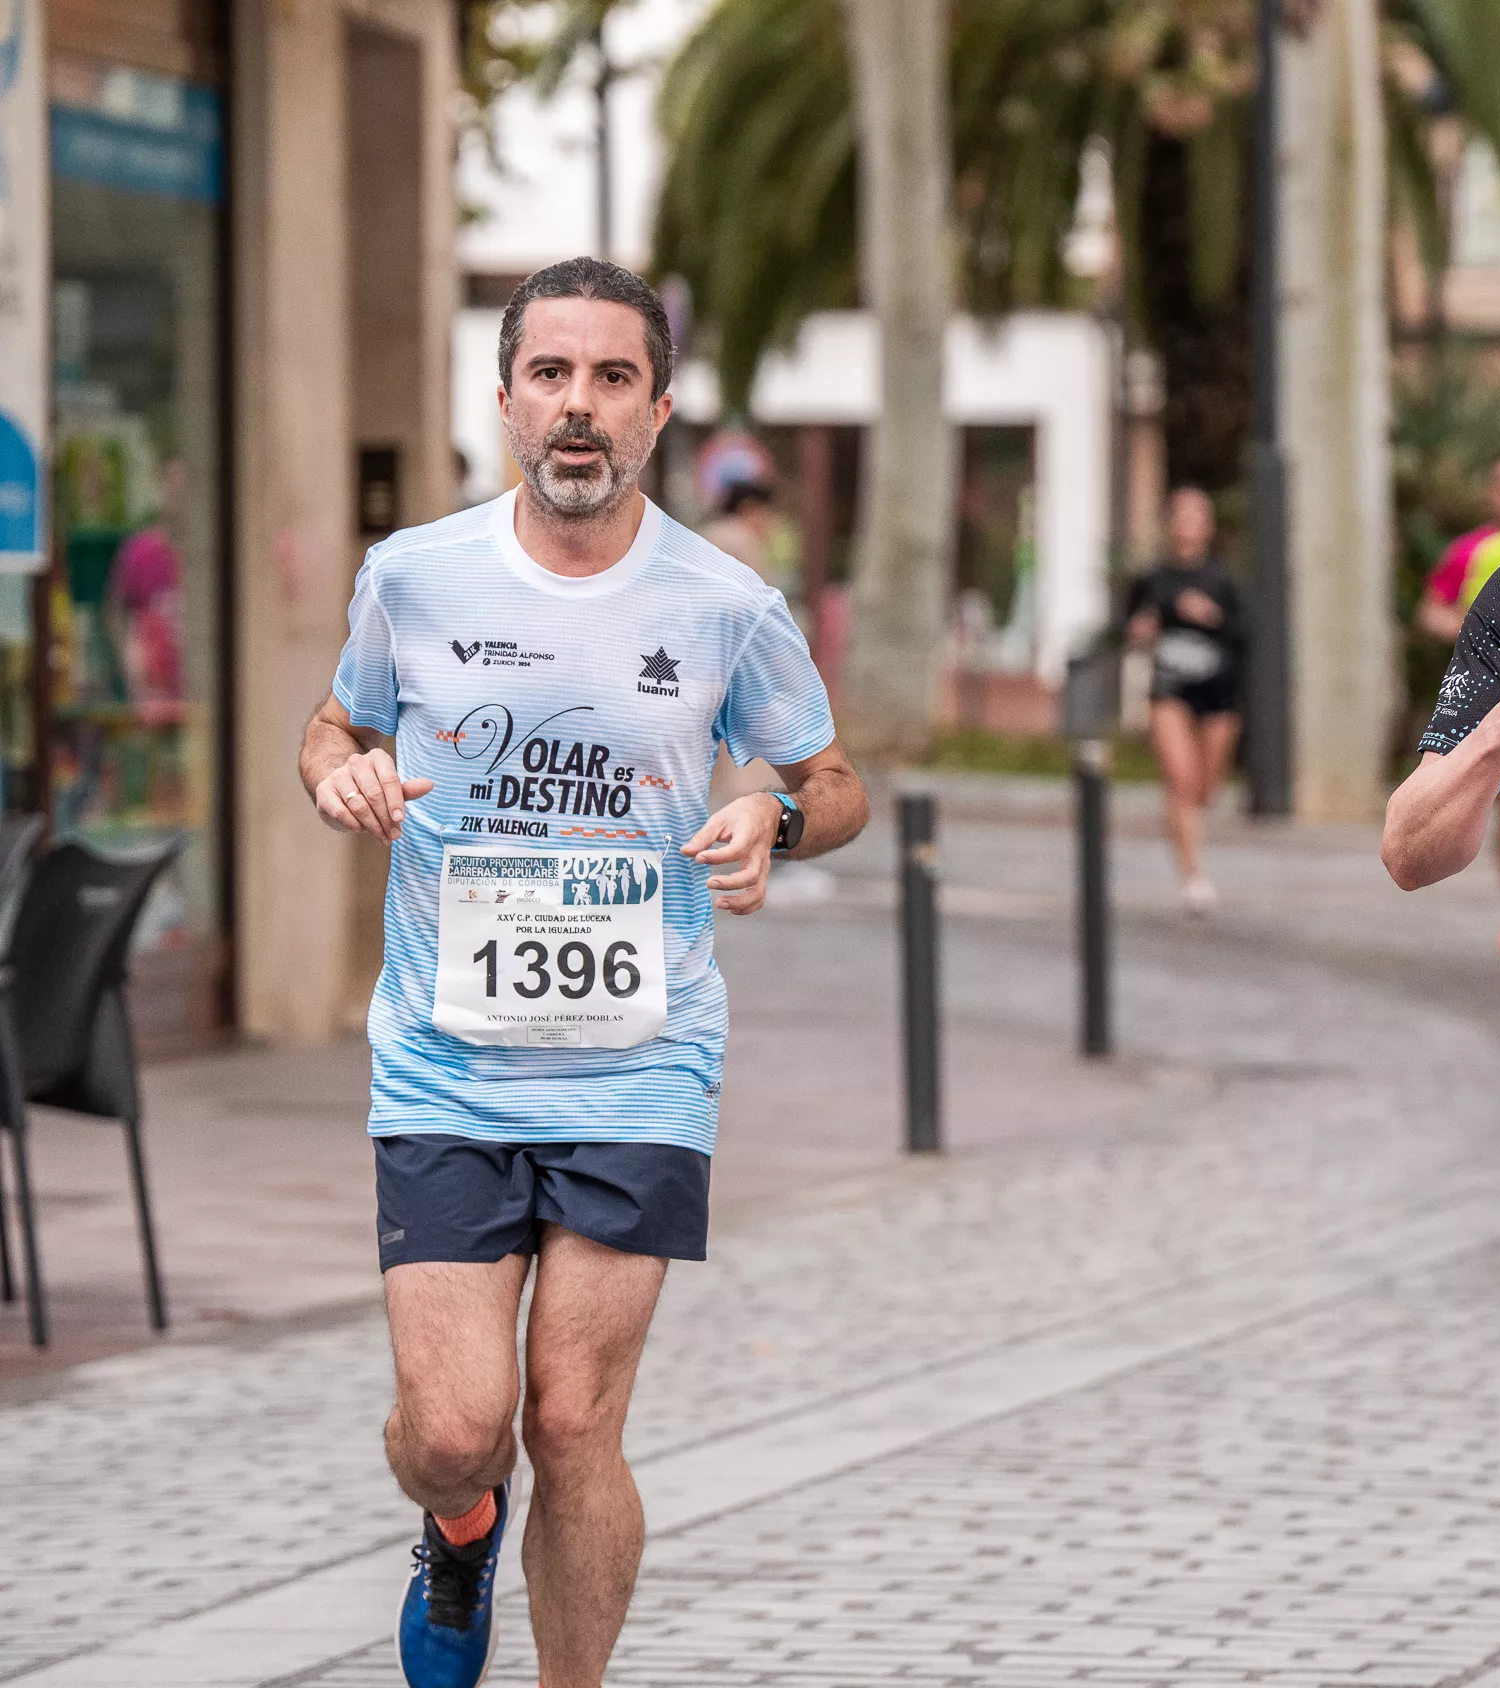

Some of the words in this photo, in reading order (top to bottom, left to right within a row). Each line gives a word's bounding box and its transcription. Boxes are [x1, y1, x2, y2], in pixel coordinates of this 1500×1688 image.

[484, 641, 517, 650] VALENCIA
[463, 645, 477, 661] 21K
[484, 649, 518, 658] TRINIDAD
[519, 652, 555, 661] ALFONSO
[637, 681, 679, 698] luanvi
[614, 766, 635, 782] es
[469, 778, 494, 800] mi
[497, 774, 632, 818] DESTINO
[459, 816, 483, 833] 21K
[487, 817, 548, 838] VALENCIA
[449, 856, 487, 867] CIRCUITO
[490, 858, 545, 868] PROVINCIAL
[548, 859, 559, 868] DE
[448, 866, 498, 877] CARRERAS
[501, 867, 560, 878] POPULARES
[562, 858, 619, 880] 2024
[502, 878, 513, 886] DE
[497, 913, 516, 922] XXV
[517, 914, 533, 922] C.P.
[534, 914, 566, 922] CIUDAD
[580, 914, 612, 922] LUCENA
[516, 926, 533, 934] POR
[534, 926, 546, 934] LA
[473, 939, 641, 1000] 1396
[529, 1013, 552, 1022] JOSÉ
[554, 1013, 584, 1022] PÉREZ
